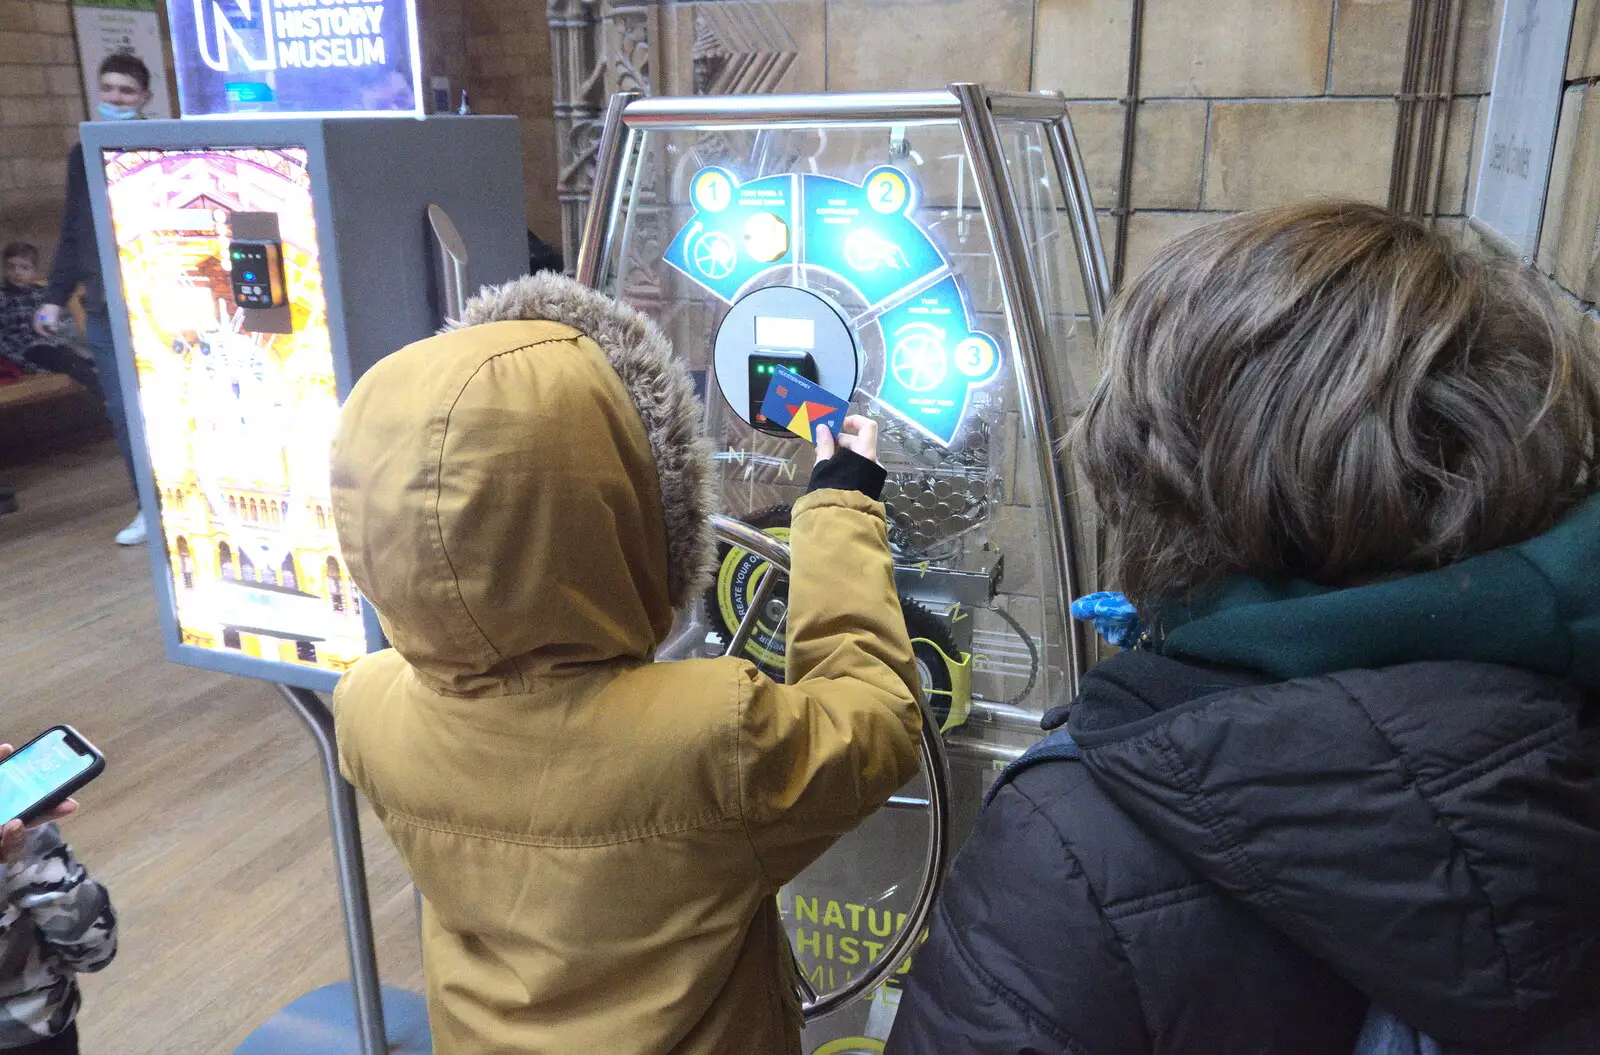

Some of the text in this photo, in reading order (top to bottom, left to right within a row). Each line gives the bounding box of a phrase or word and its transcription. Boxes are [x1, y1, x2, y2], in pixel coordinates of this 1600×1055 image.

[275, 5, 384, 38] HISTORY
[278, 37, 386, 68] MUSEUM
[707, 181, 717, 202] 1
[879, 180, 893, 203] 2
[967, 345, 981, 367] 3
[734, 561, 751, 618] REATE YOUR
[795, 895, 909, 937] NATU
[797, 928, 911, 974] HIST
